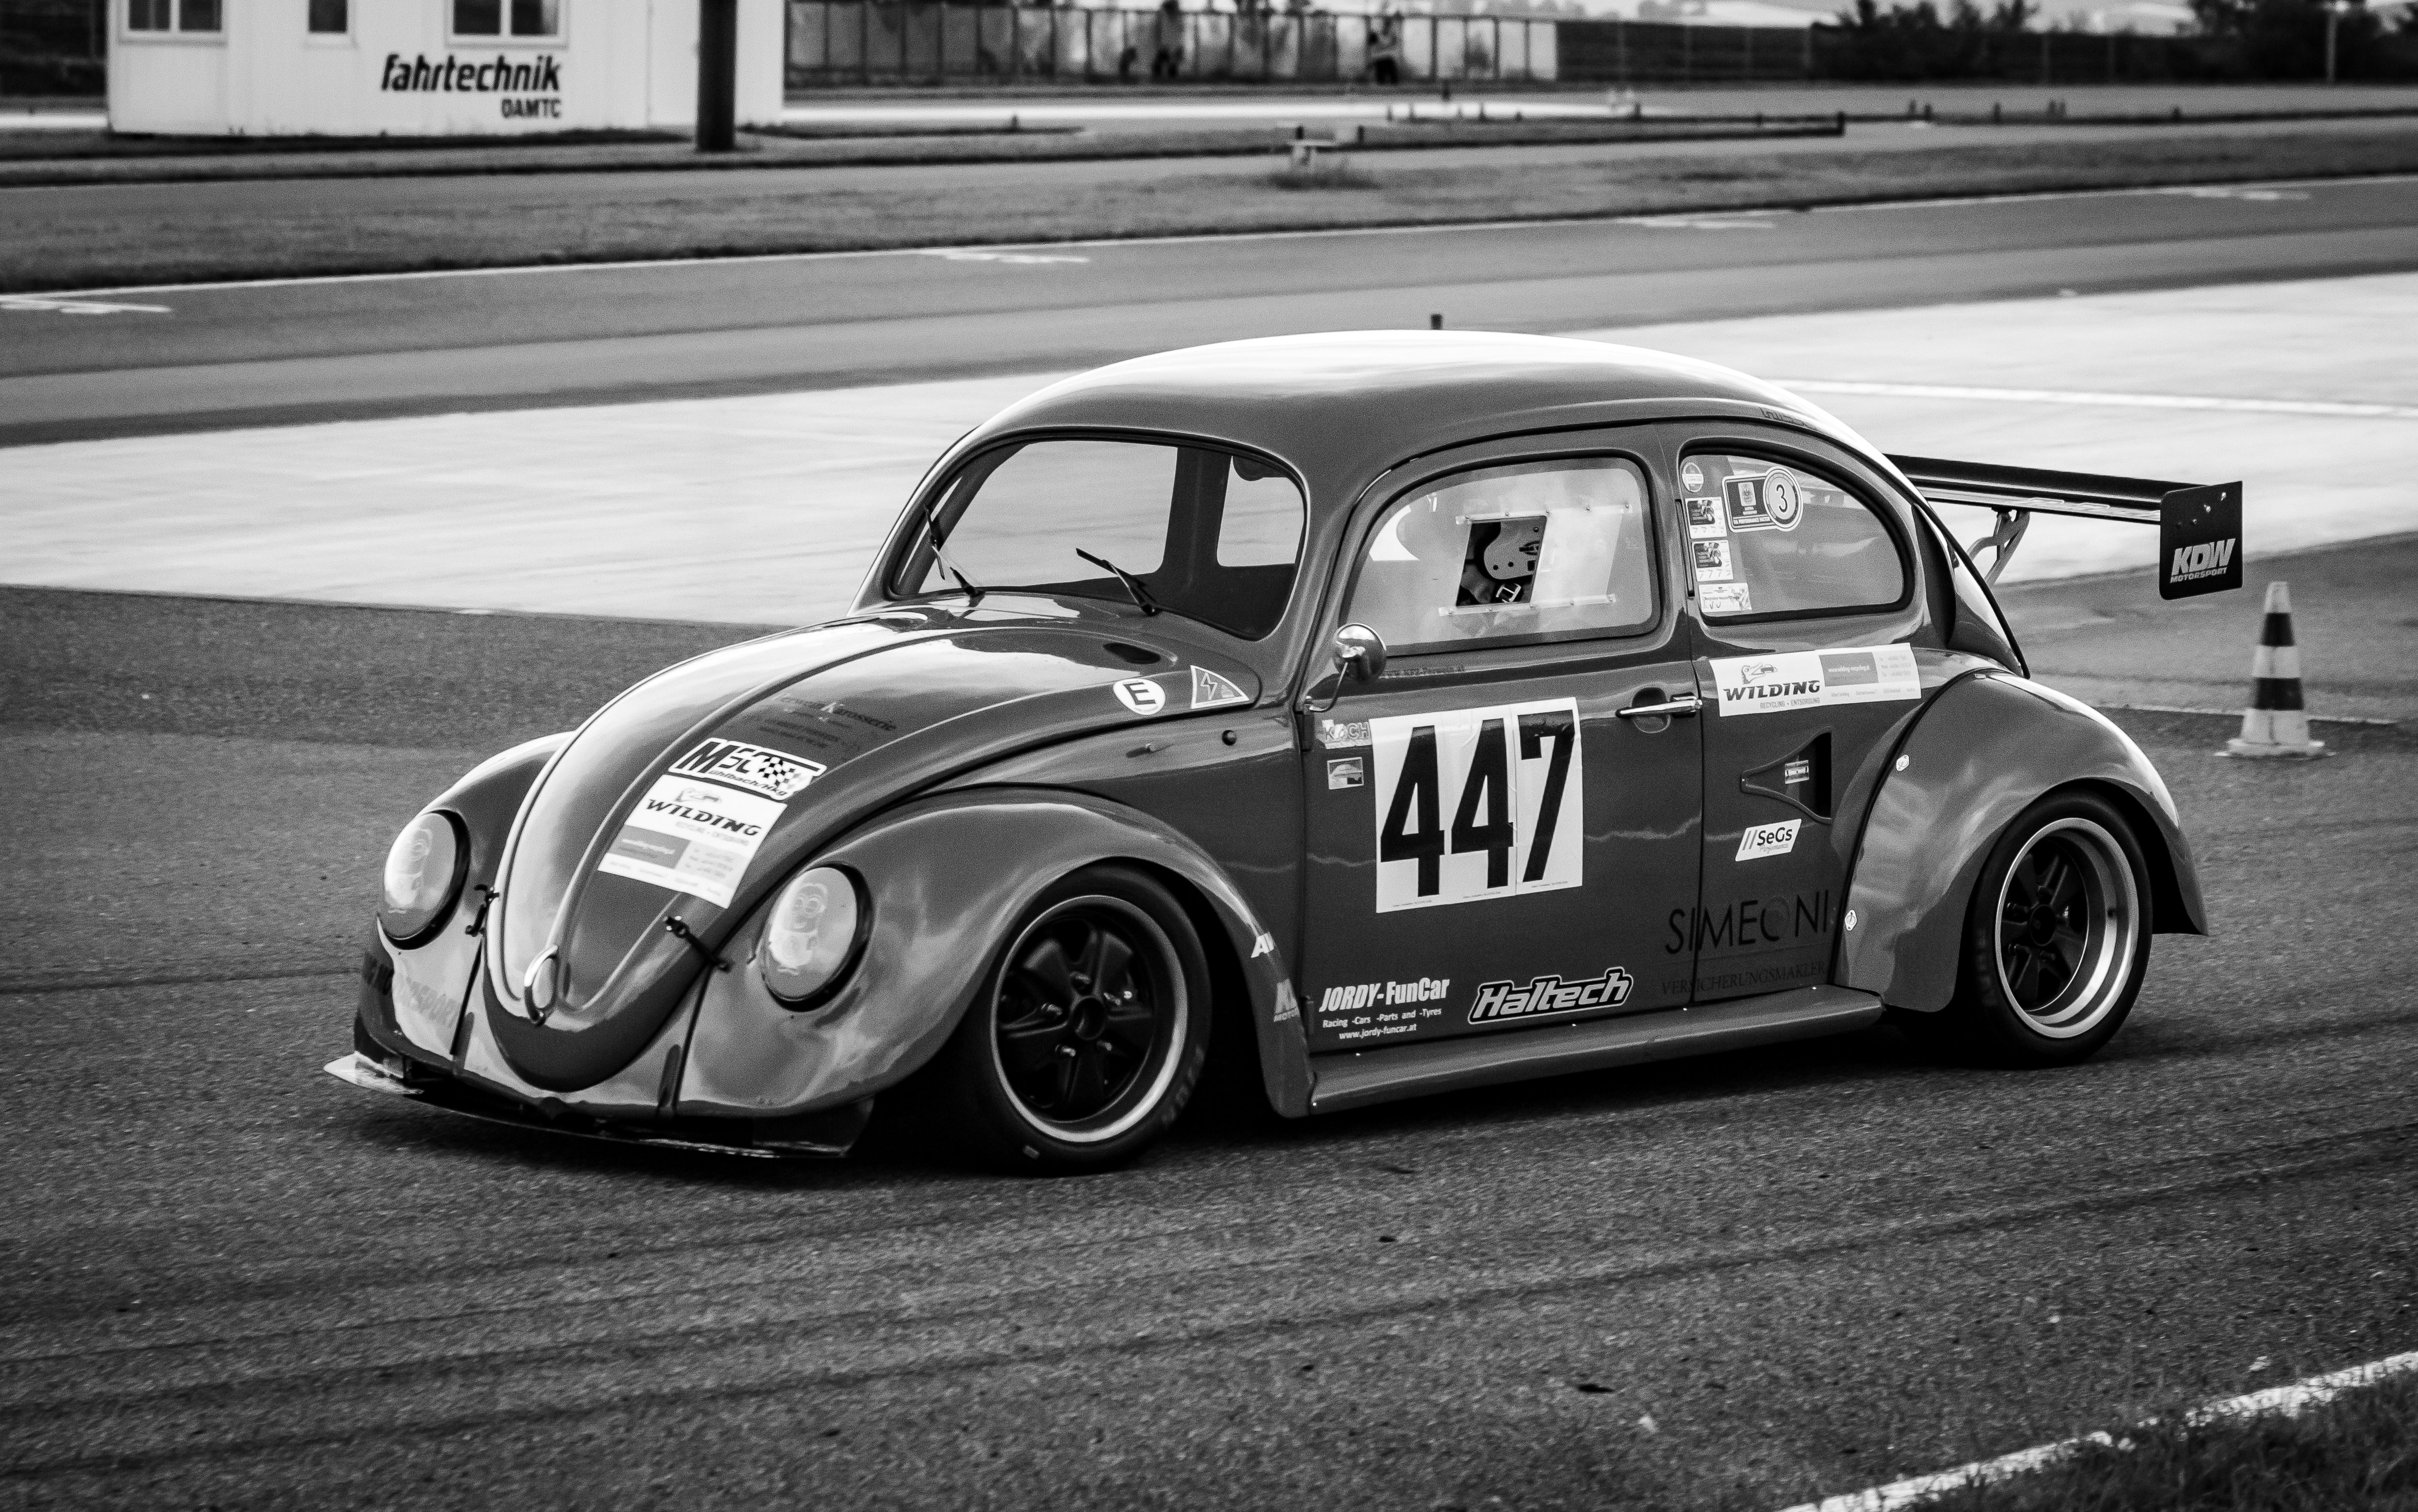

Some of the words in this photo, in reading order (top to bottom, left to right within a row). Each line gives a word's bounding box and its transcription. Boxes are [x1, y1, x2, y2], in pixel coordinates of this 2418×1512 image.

[381, 53, 561, 92] fahrtechnik
[1776, 484, 1788, 513] 3
[2171, 538, 2236, 577] KDW
[2170, 567, 2227, 583] MOTORSPORT
[1122, 681, 1156, 706] E
[1723, 680, 1820, 701] WILDING
[1760, 701, 1785, 709] RECYCLING
[1380, 709, 1576, 898] 447
[646, 799, 762, 836] WILDING
[1757, 827, 1793, 846] SeGs
[1319, 977, 1450, 1012] JORDY-FunCar
[1473, 972, 1629, 1019] Haltech
[1323, 1018, 1348, 1028] Racing
[1401, 1010, 1416, 1019] and
[1339, 1024, 1417, 1039] www.jordy-funcar.at
